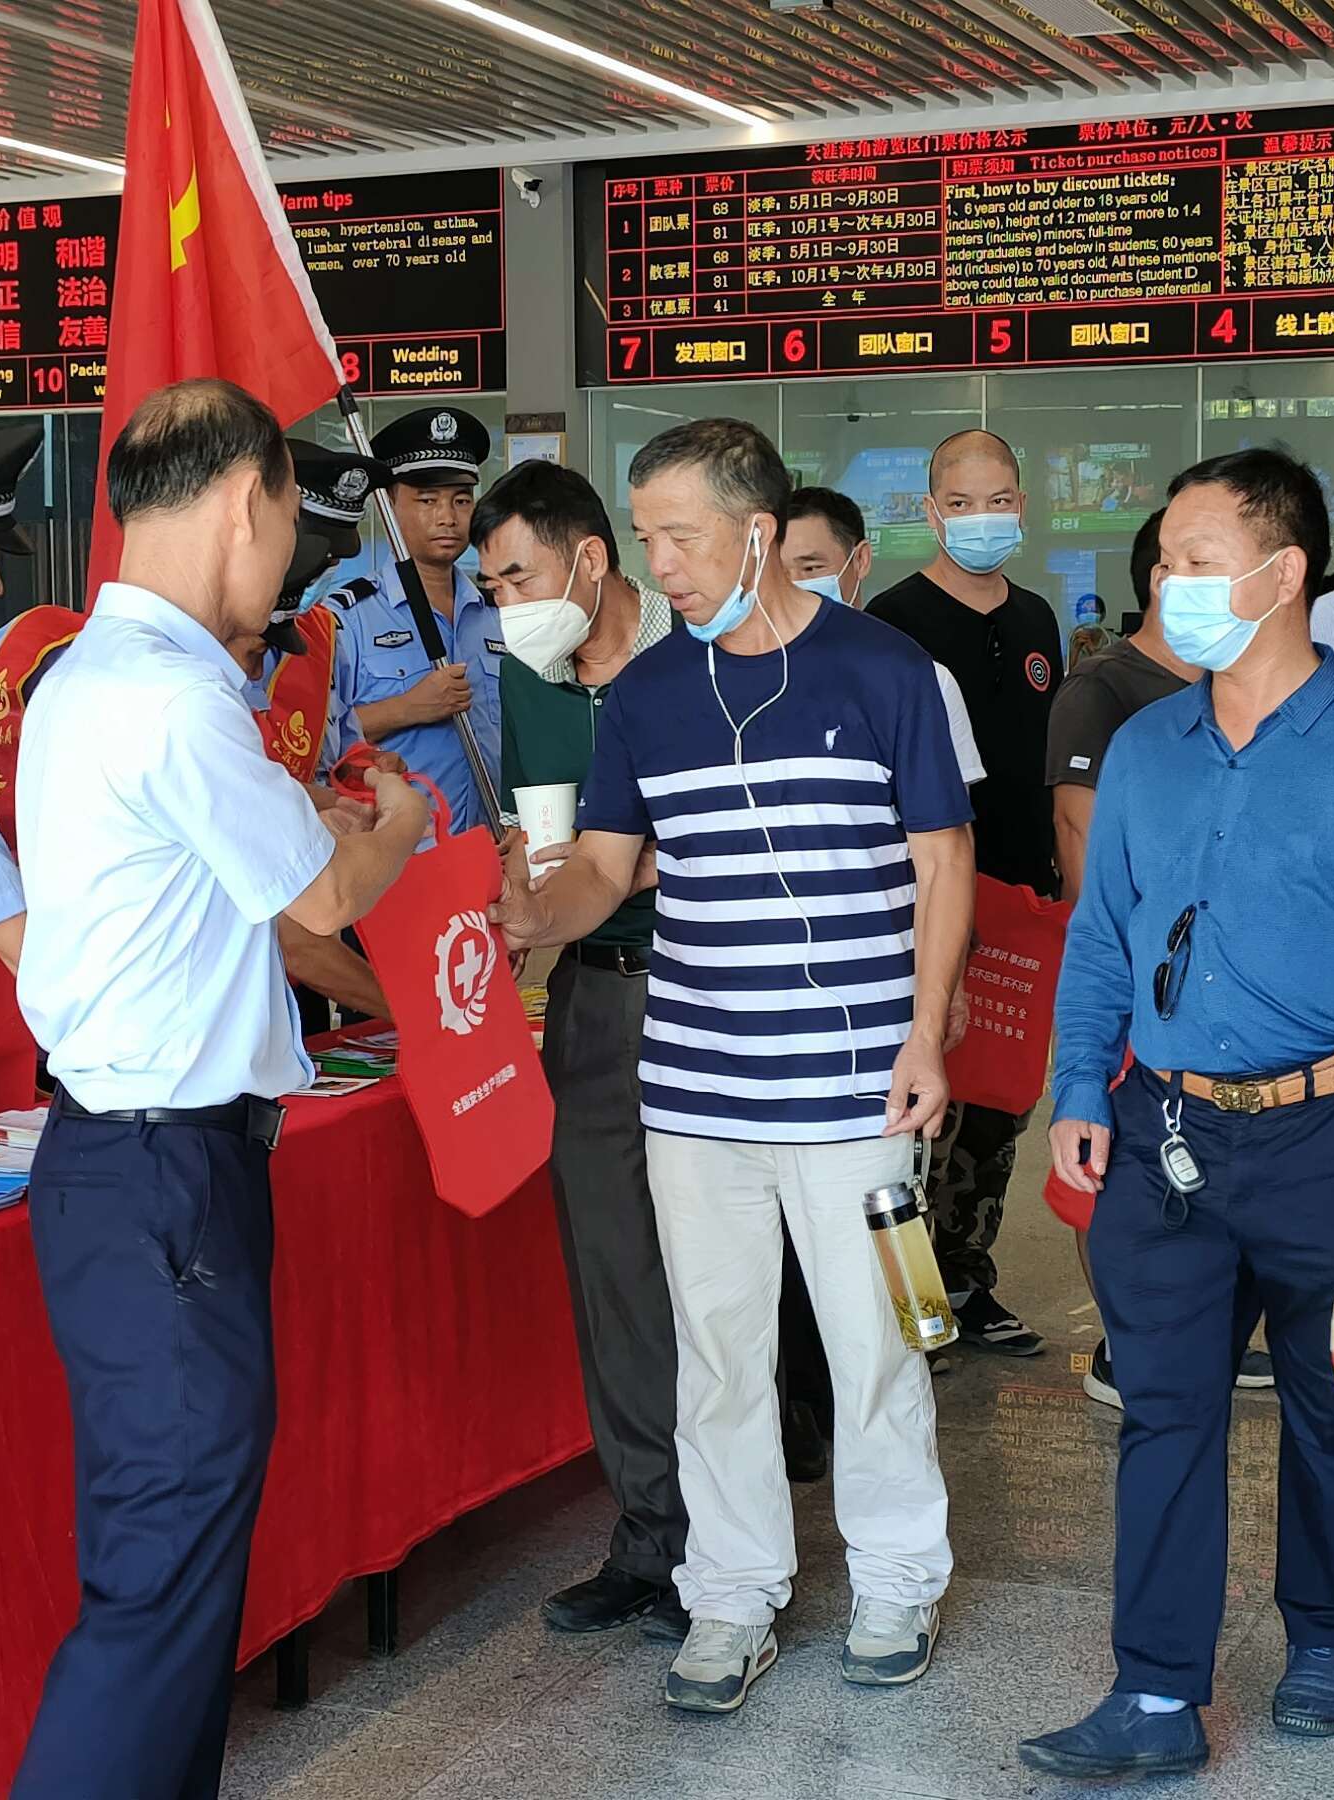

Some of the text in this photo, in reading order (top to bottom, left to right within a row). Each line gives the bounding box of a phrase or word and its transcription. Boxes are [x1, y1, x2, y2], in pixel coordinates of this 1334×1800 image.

[805, 130, 1028, 161] 天涯海角游览区门票价格公示
[1264, 133, 1333, 154] 温馨提示
[952, 146, 1217, 177] 购票须知 Ticket purchase notices
[613, 167, 876, 197] 序号 票种 票价 淡旺季时间
[945, 173, 1176, 200] First, how to buy discount tickets:
[322, 191, 353, 211] tips
[713, 202, 729, 215] 68
[965, 203, 972, 215] 6
[974, 204, 1005, 218] years
[1008, 200, 1025, 212] old
[1028, 198, 1048, 211] and
[1052, 196, 1082, 209] older
[1084, 195, 1095, 207] to
[1099, 194, 1113, 206] 18
[1115, 195, 1147, 209] years
[1150, 191, 1169, 203] old
[340, 217, 478, 237] hypertension, asthma,
[622, 221, 629, 233] 1
[649, 214, 690, 233] 团队票
[713, 226, 729, 240] 81
[946, 204, 1201, 234] (inclusive), height of 1.2 meters or more to 1.4
[56, 236, 106, 269] 和谐
[307, 232, 493, 254] lumbar vertebral disease and
[307, 250, 466, 271] women, over 70 years old
[713, 251, 729, 264] 68
[622, 269, 631, 281] 2
[649, 262, 690, 281] 散客票
[713, 275, 729, 289] 81
[57, 276, 106, 308] 法治
[622, 304, 631, 317] 3
[650, 298, 690, 316] 优惠票
[713, 299, 728, 313] 41
[59, 316, 107, 347] 友善
[620, 337, 641, 369] 7
[676, 341, 746, 363] 发票窗口
[784, 329, 805, 362] 6
[859, 332, 933, 356] 团队窗口
[990, 320, 1011, 354] 5
[1071, 321, 1150, 346] 团队窗口
[1210, 308, 1237, 344] 4
[342, 352, 360, 383] 8
[392, 346, 459, 364] Wedding
[34, 367, 63, 393] 10
[390, 367, 461, 386] Reception
